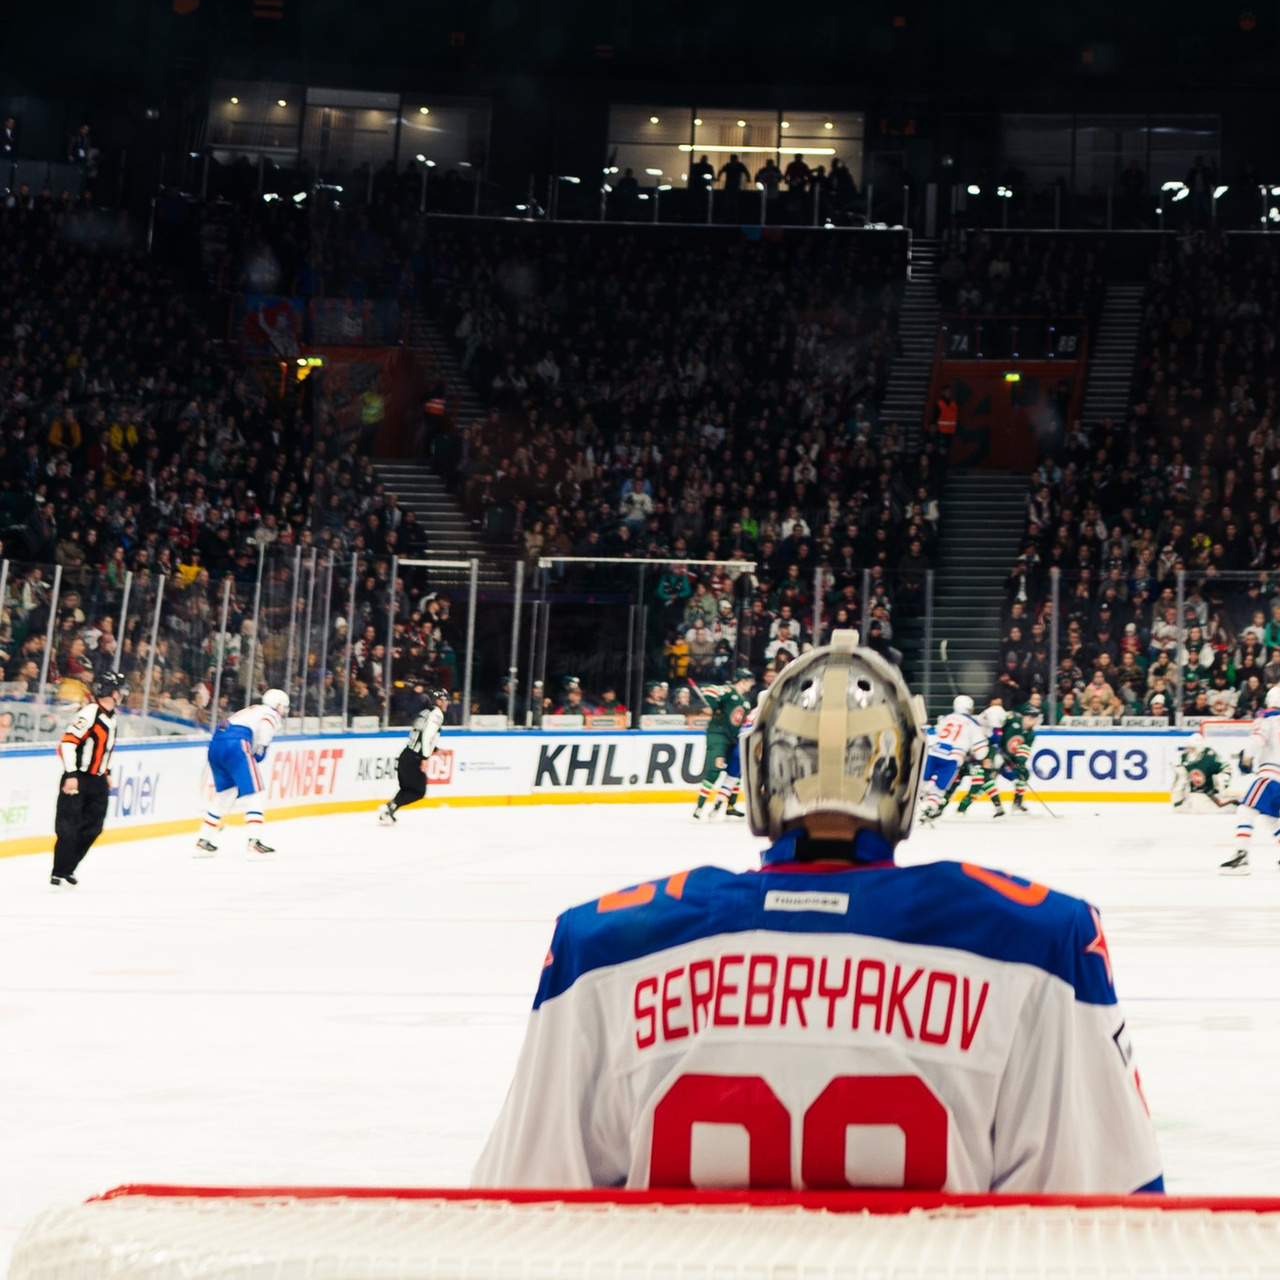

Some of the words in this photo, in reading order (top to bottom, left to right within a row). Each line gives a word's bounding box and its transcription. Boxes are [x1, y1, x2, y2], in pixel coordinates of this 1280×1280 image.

[268, 748, 345, 800] FONBET
[534, 742, 708, 787] KHL.RU
[632, 953, 990, 1052] SEREBRYAKOV
